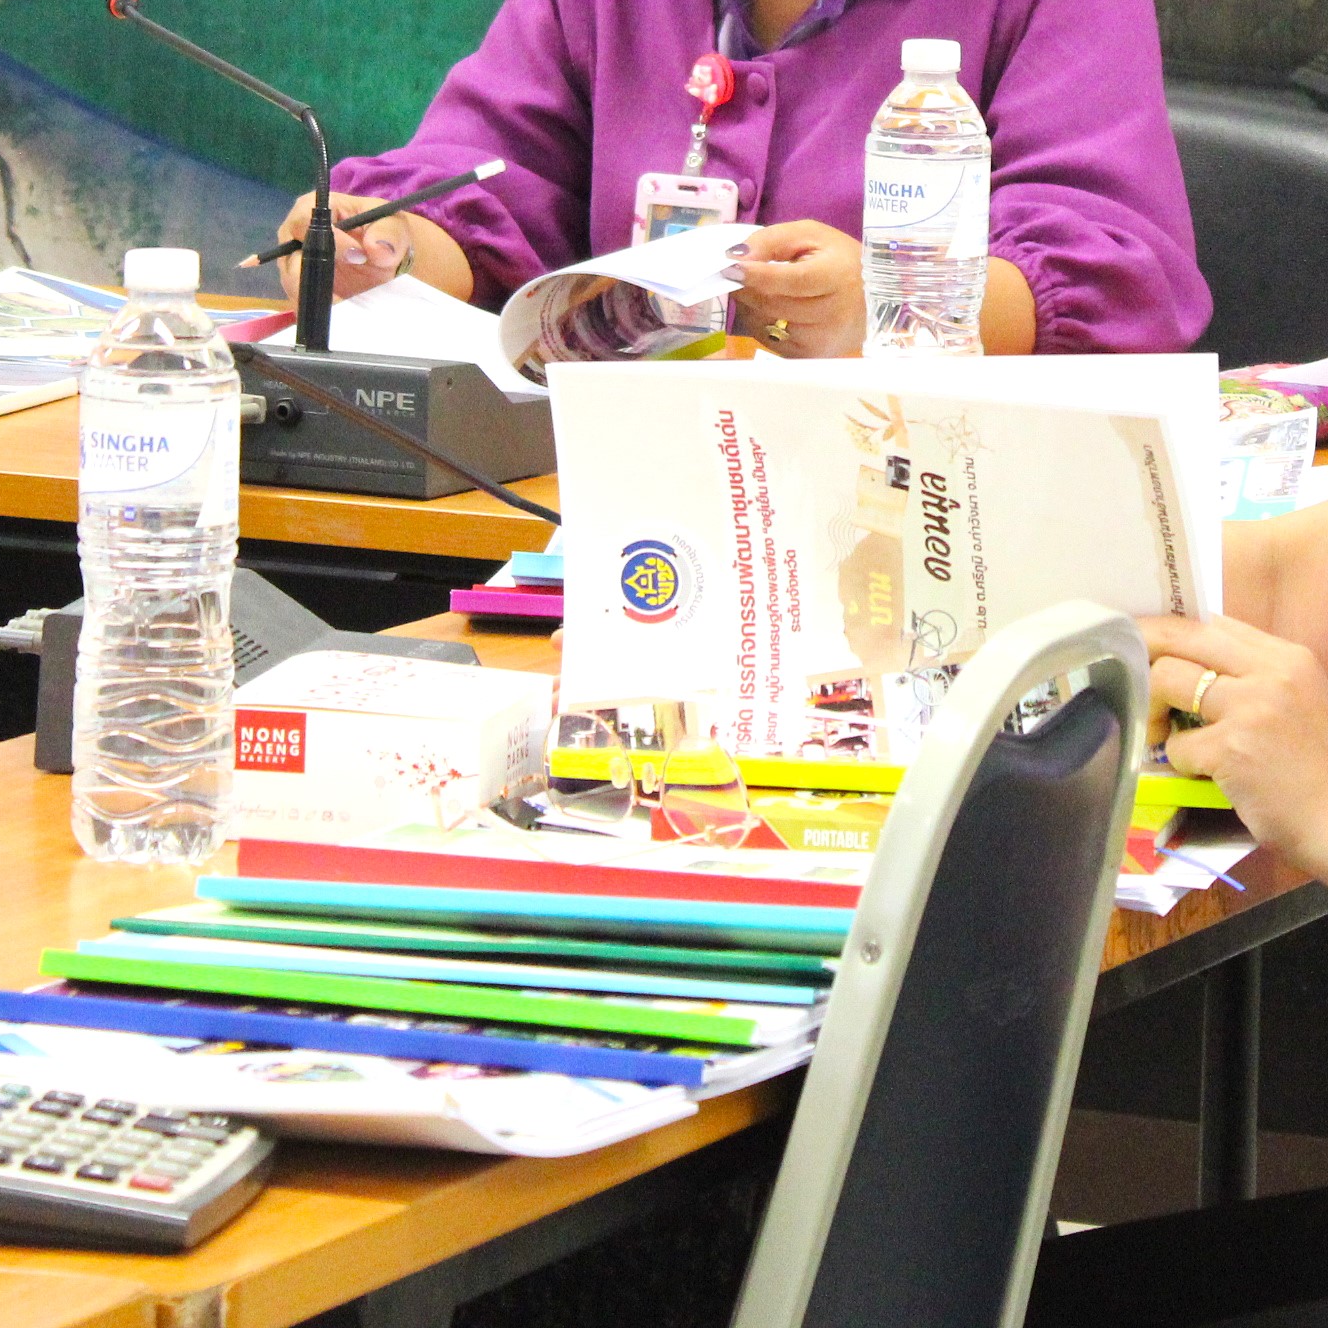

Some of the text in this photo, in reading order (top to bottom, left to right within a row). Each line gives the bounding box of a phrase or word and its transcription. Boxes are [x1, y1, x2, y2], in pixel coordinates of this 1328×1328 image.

[868, 179, 926, 199] SINGHA
[868, 196, 909, 213] WATER
[355, 388, 416, 412] NPE
[91, 431, 170, 453] SINGHA
[919, 471, 961, 583] ดอนมูล
[240, 726, 301, 744] NONG
[239, 754, 287, 764] BAKERY
[240, 741, 300, 757] DAENG
[803, 828, 870, 849] PORTABLE
